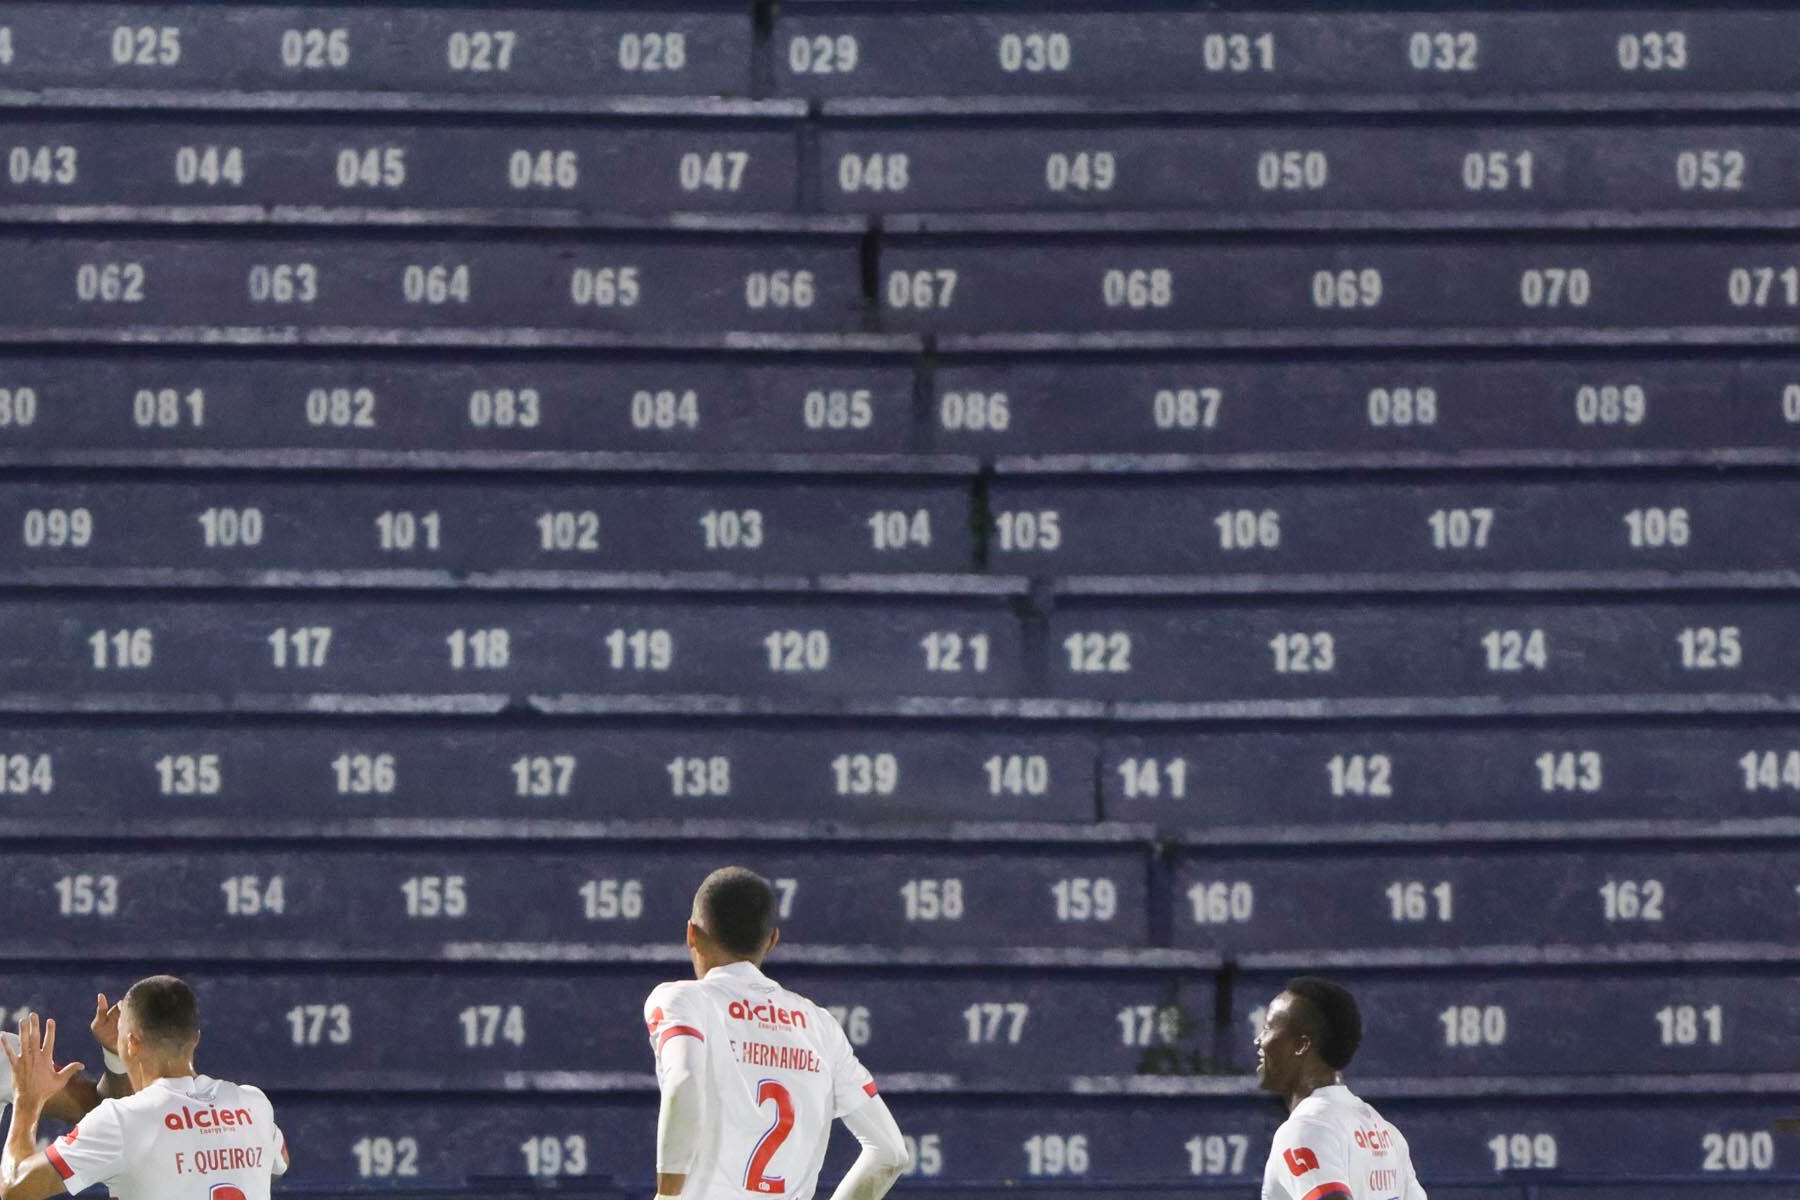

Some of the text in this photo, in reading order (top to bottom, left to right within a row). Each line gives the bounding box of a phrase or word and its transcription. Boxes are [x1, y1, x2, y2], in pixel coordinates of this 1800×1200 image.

[111, 25, 181, 65] 025
[447, 30, 517, 71] 027
[618, 32, 686, 71] 028
[998, 33, 1071, 71] 030
[1408, 32, 1478, 70] 032
[1617, 31, 1688, 69] 033
[8, 146, 77, 184] 043
[336, 148, 406, 187] 045
[508, 150, 578, 188] 046
[838, 153, 909, 191] 048
[1046, 152, 1116, 190] 049
[1463, 150, 1533, 189] 051
[249, 263, 318, 302] 063
[571, 267, 640, 306] 065
[745, 271, 814, 307] 066
[1103, 269, 1172, 307] 068
[1312, 269, 1382, 307] 069
[1728, 267, 1799, 305] 071
[133, 389, 204, 426] 081
[469, 389, 540, 427] 083
[803, 390, 873, 428] 085
[940, 392, 1010, 430] 086
[1368, 388, 1437, 425] 088
[1575, 385, 1646, 424] 089
[198, 508, 264, 547] 100
[536, 511, 600, 550] 102
[699, 509, 764, 548] 103
[995, 510, 1061, 550] 105
[1214, 509, 1281, 549] 106
[88, 628, 153, 669] 116
[445, 628, 511, 669] 118
[763, 630, 830, 671] 120
[920, 632, 989, 672] 121
[1269, 631, 1335, 672] 123
[1480, 629, 1548, 670] 124
[154, 754, 222, 794] 135
[331, 754, 396, 793] 136
[666, 756, 731, 796] 138
[983, 755, 1049, 795] 140
[1117, 758, 1187, 798] 141
[1534, 751, 1603, 791] 143
[54, 874, 119, 915] 153
[220, 876, 285, 914] 154
[401, 875, 468, 916] 155
[578, 880, 643, 919] 156
[900, 879, 964, 920] 158
[1051, 878, 1117, 920] 159
[1186, 881, 1254, 923] 160
[1385, 882, 1452, 921] 161
[1599, 879, 1664, 920] 162
[286, 1004, 351, 1044] 173
[458, 1005, 526, 1046] 174
[729, 998, 807, 1029] alcien
[963, 1003, 1029, 1043] 177
[1439, 1006, 1507, 1046] 180
[1655, 1005, 1723, 1044] 181
[164, 1104, 253, 1131] alcien
[742, 1079, 795, 1194] 2
[175, 1147, 263, 1174] F. QUEIROZ
[352, 1138, 418, 1177] 192
[520, 1135, 588, 1176] 193
[1023, 1134, 1089, 1175] 196
[1184, 1135, 1247, 1175] 197
[1487, 1134, 1558, 1171] 199
[1702, 1131, 1774, 1171] 200
